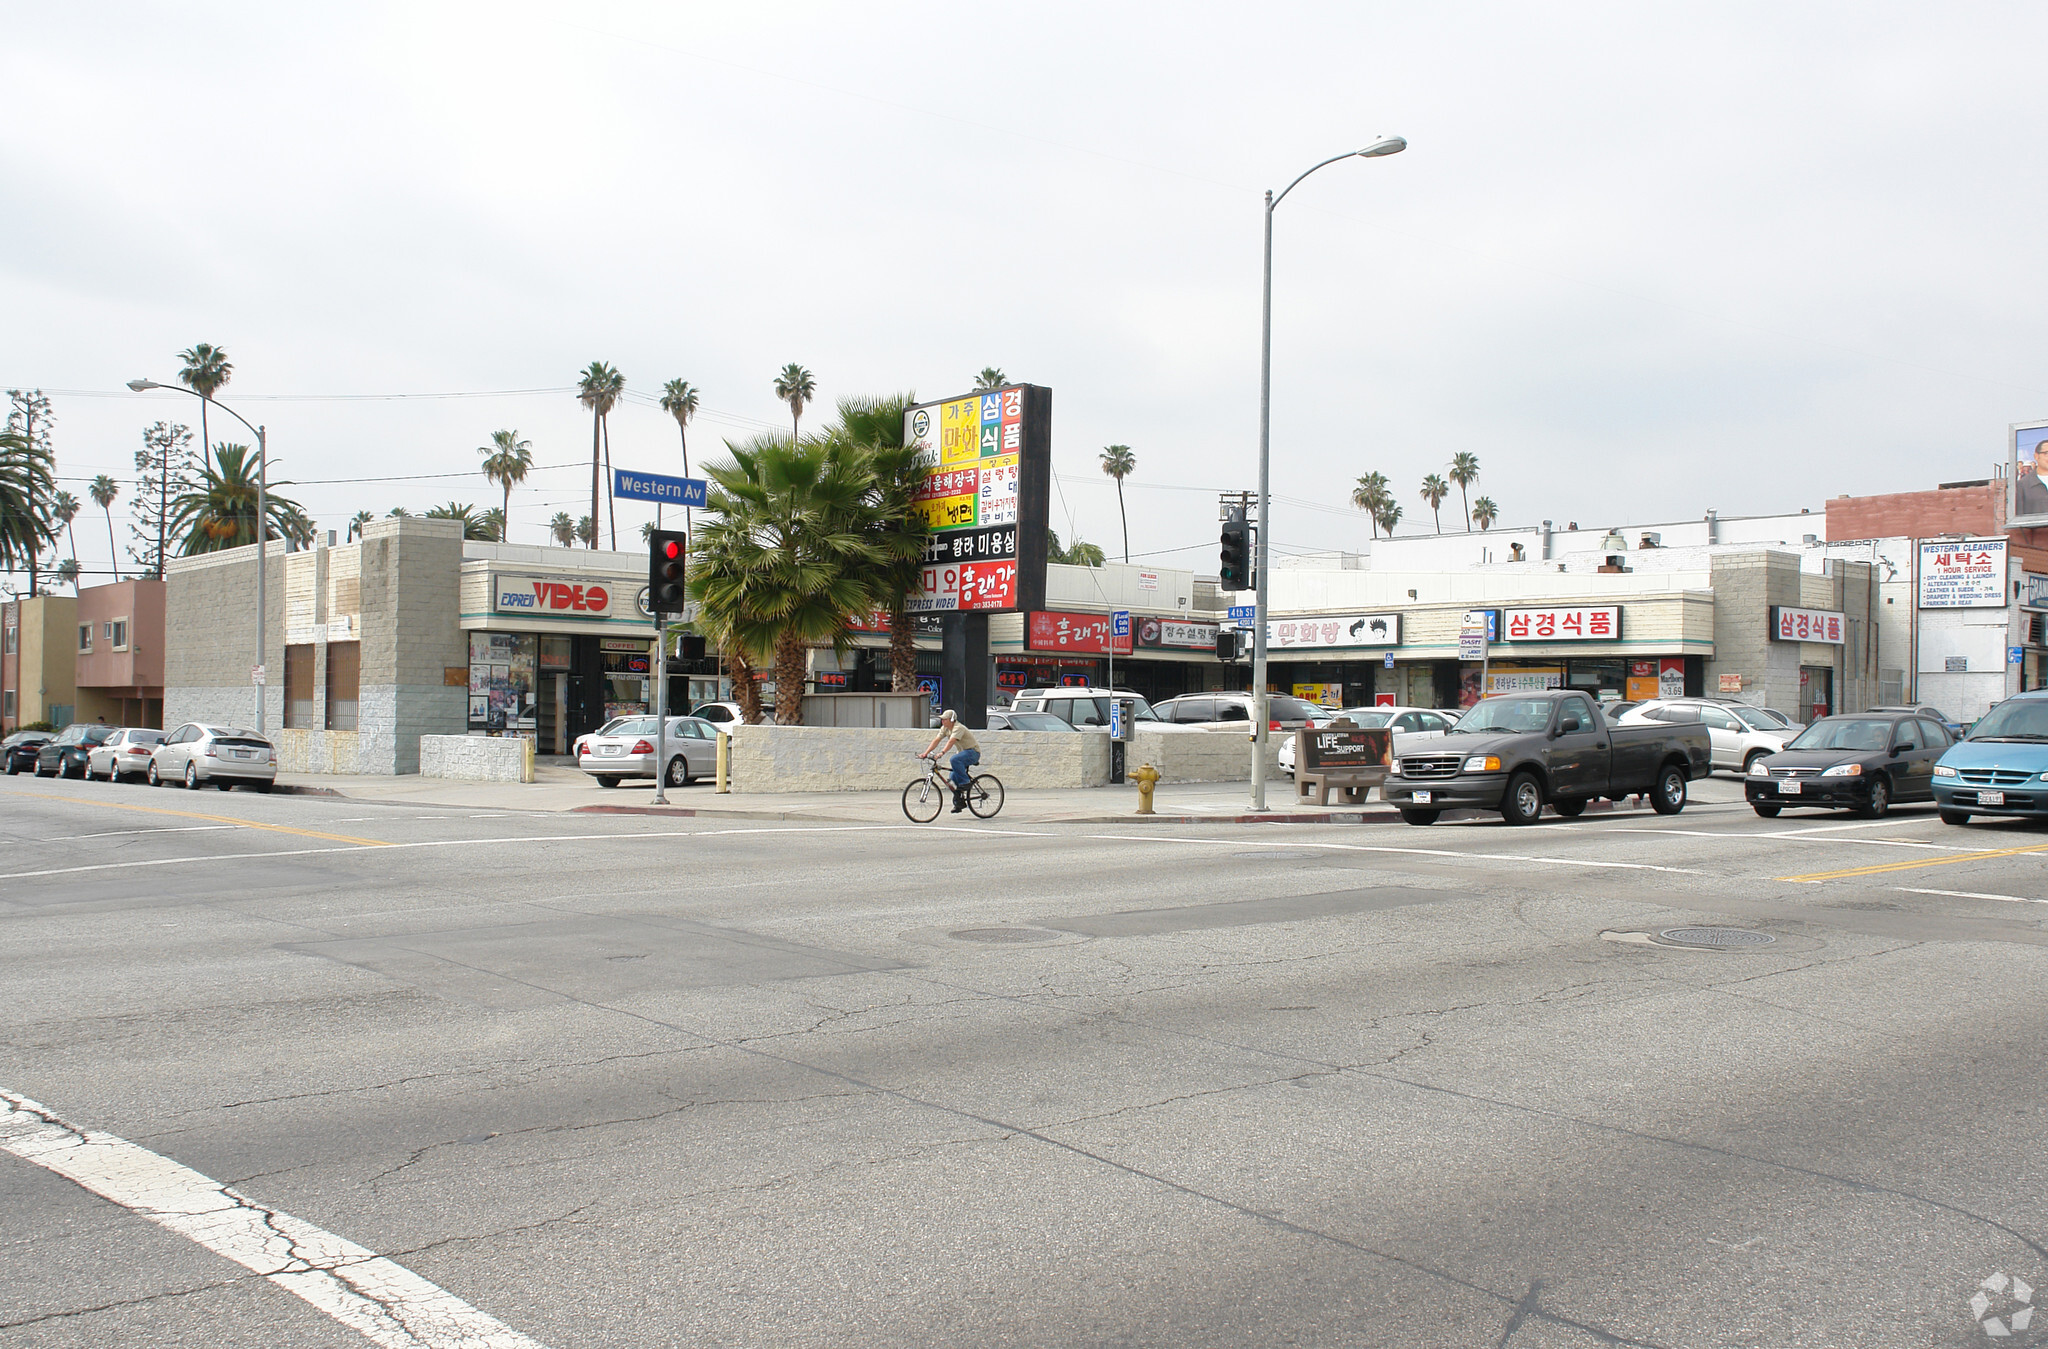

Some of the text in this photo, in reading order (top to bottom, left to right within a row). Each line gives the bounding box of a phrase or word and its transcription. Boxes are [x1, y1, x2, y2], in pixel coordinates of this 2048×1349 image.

[948, 402, 974, 420] 가주
[983, 389, 1021, 420] 삼경
[945, 425, 977, 458] 만화
[982, 422, 1020, 452] 식품
[912, 440, 933, 452] offee
[621, 475, 702, 499] Western Av
[1923, 543, 2004, 554] WESTERN CLEANERS
[1933, 552, 1992, 566] 세탁소
[500, 592, 537, 608] EXPRESS
[532, 582, 608, 612] VIDEO
[935, 598, 956, 609] VIDEO
[1231, 607, 1253, 617] 4th St
[1509, 611, 1611, 637] 삼경식품
[1780, 612, 1841, 641] 삼경식품
[1278, 622, 1341, 645] 만화방
[628, 661, 648, 670] OPEN
[1660, 675, 1684, 683] Marlboro
[1667, 687, 1683, 696] 3.69
[1316, 736, 1338, 749] LIFE
[1336, 744, 1365, 753] SUPPORT
